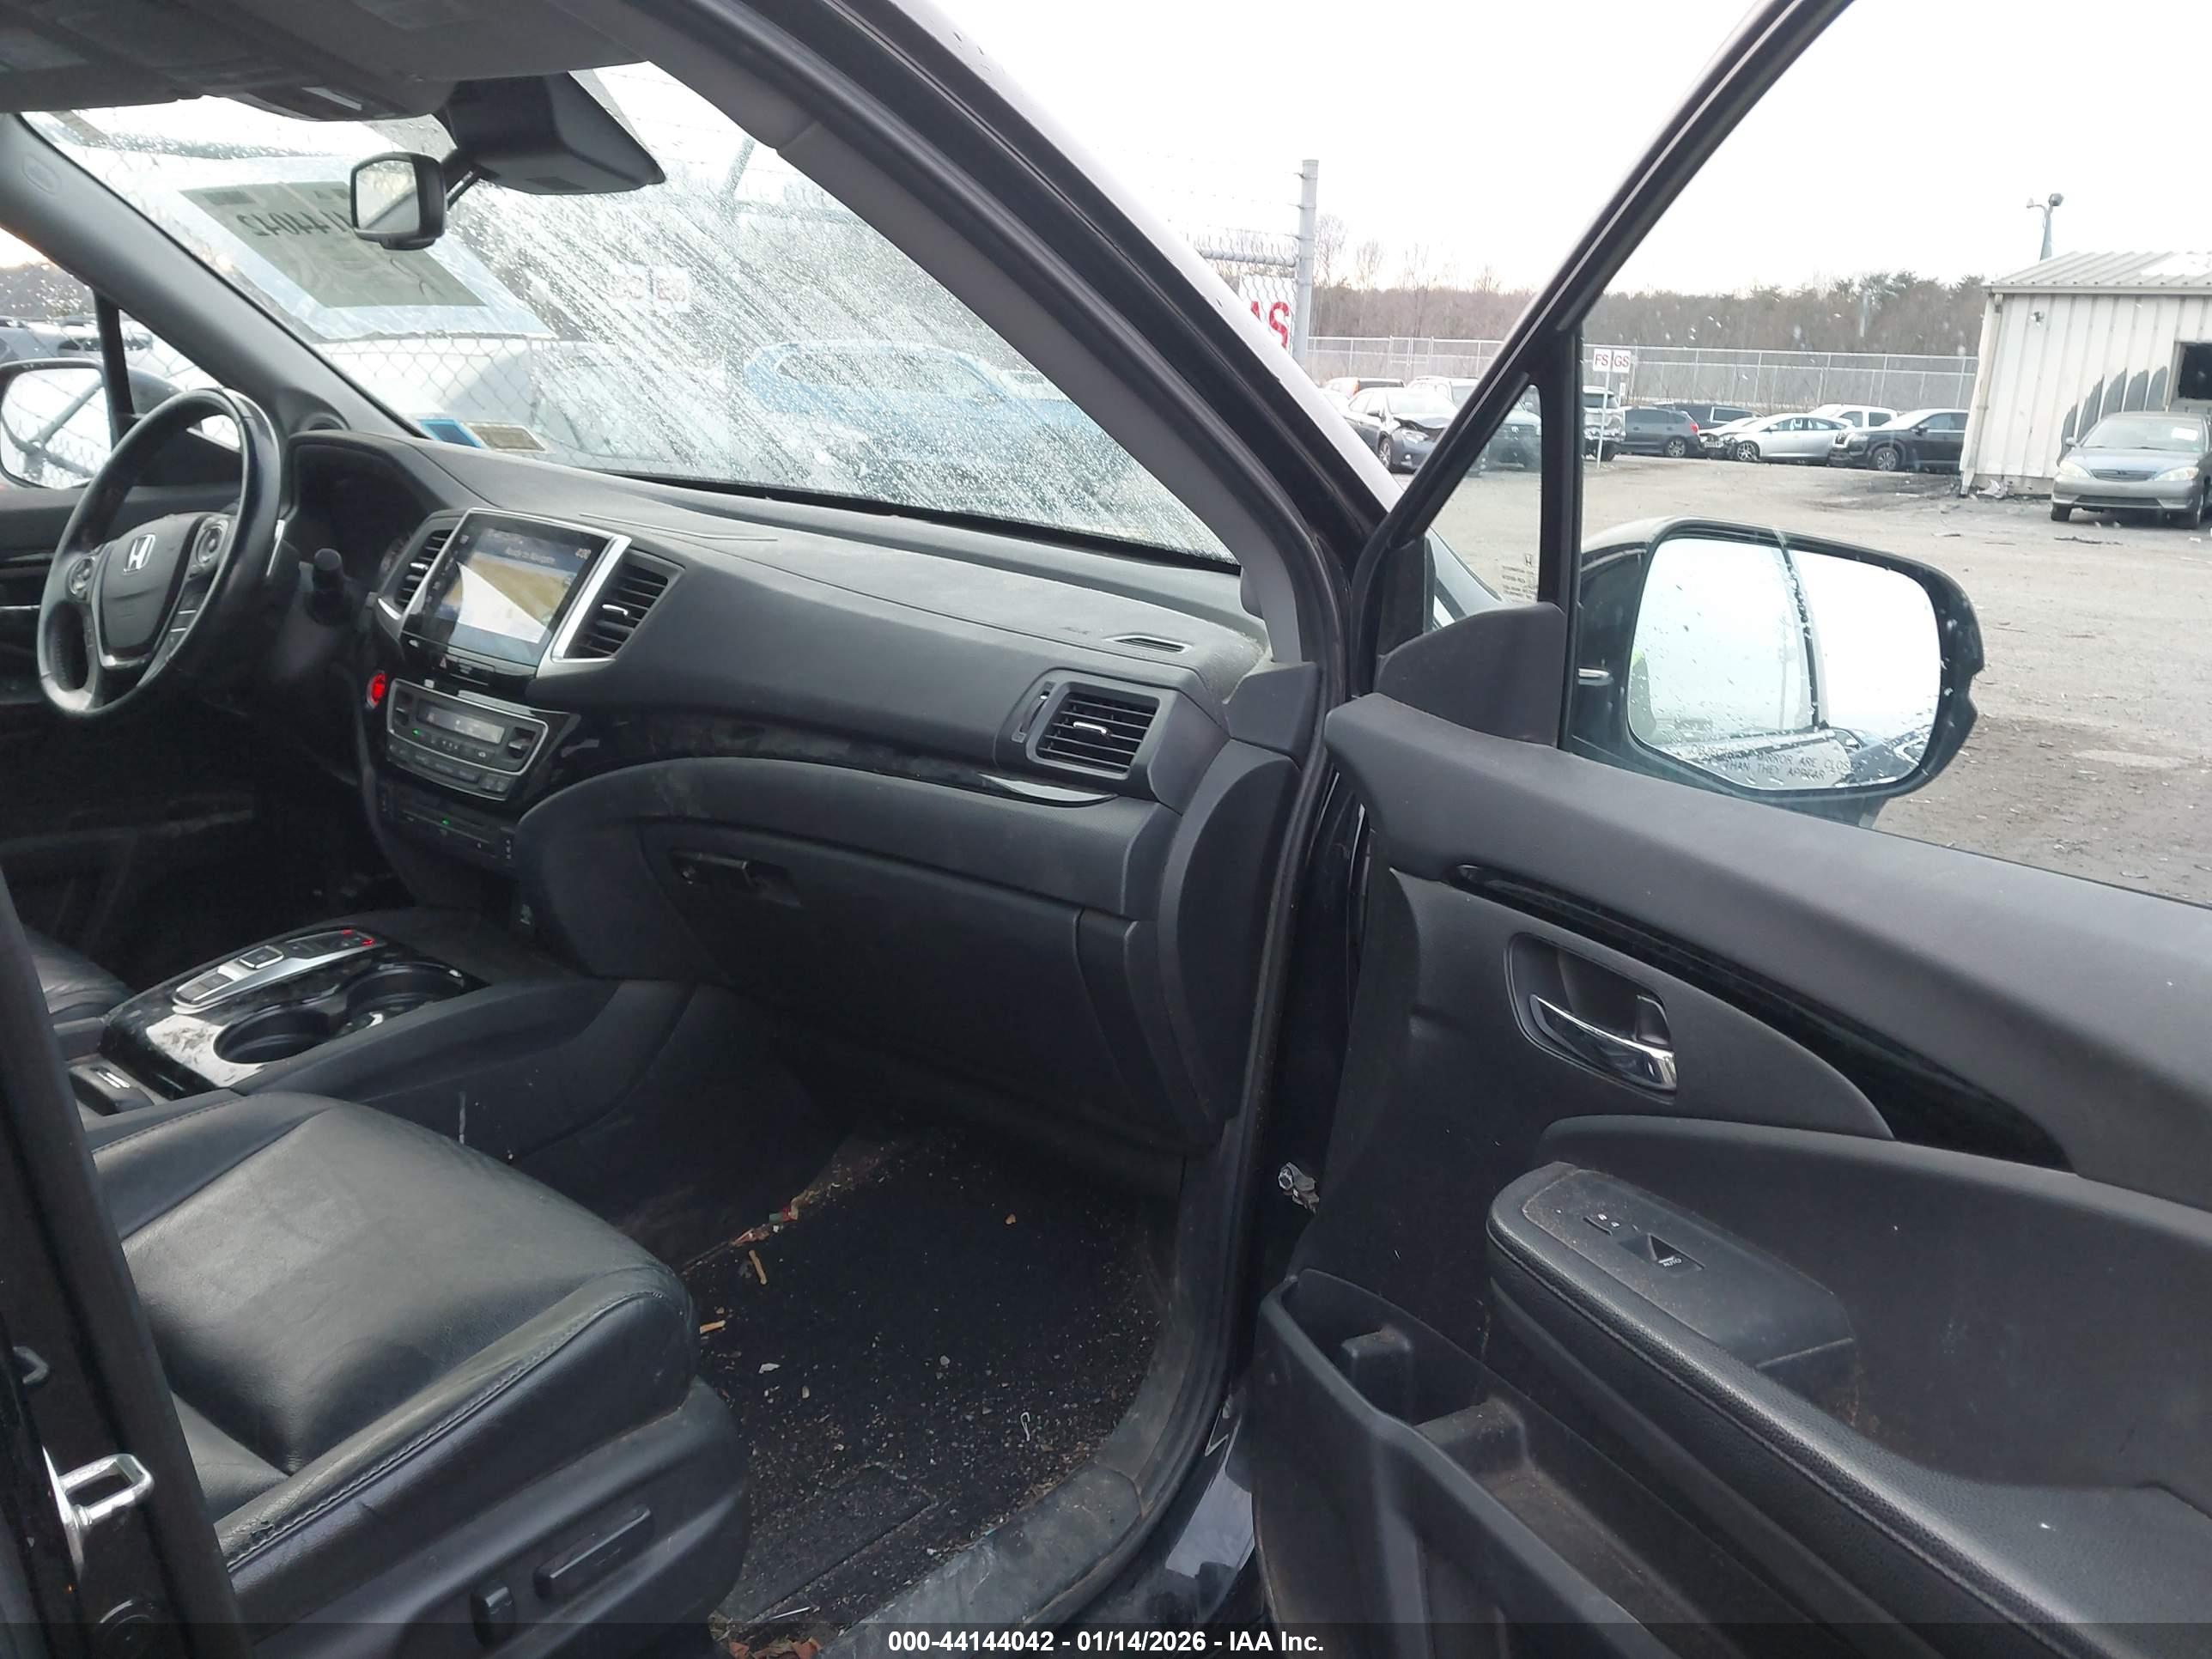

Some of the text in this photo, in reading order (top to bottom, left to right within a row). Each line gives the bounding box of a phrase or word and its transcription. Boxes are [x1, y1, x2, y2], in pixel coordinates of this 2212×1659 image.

[1595, 354, 1609, 367] FS
[1613, 355, 1630, 368] GS
[1662, 1257, 1682, 1267] AUTO
